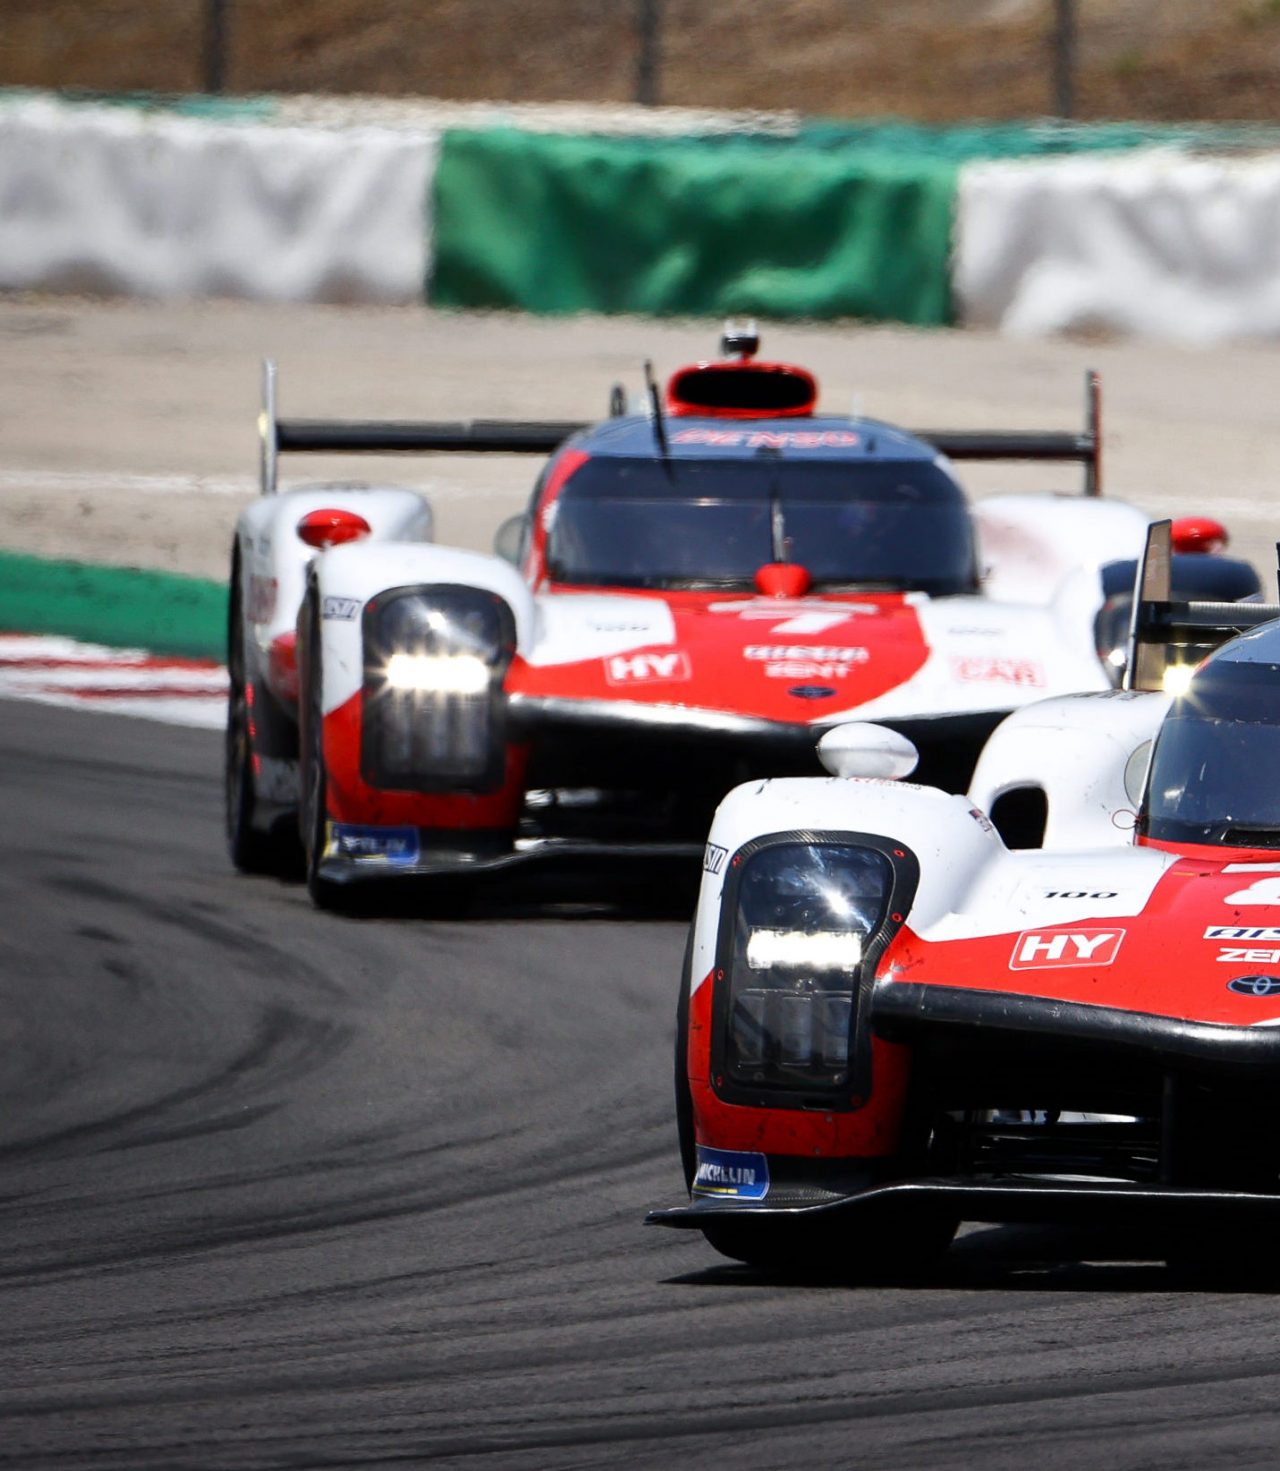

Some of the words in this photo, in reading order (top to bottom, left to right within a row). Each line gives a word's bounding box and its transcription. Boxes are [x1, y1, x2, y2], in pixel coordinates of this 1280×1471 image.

[738, 608, 854, 635] 7
[610, 653, 679, 681] HY
[1043, 891, 1119, 899] 100
[1018, 933, 1116, 962] HY
